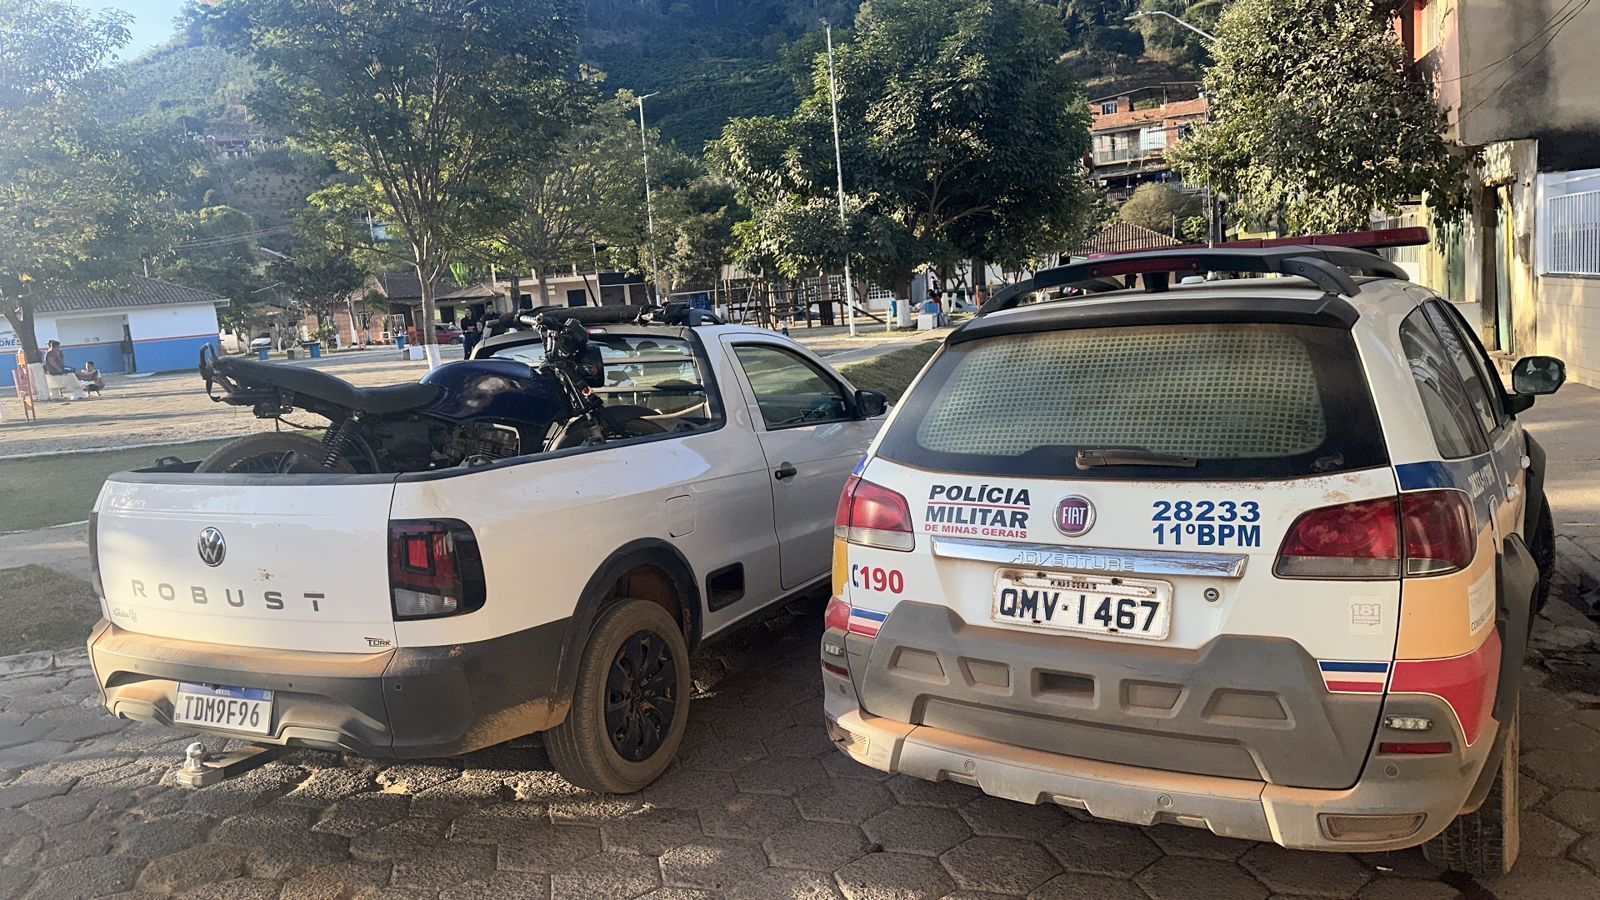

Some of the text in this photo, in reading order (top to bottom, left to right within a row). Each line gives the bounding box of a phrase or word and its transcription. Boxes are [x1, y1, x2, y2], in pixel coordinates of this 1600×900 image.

[929, 484, 1031, 506] POLÍCIA
[925, 506, 1029, 529] MILITAR
[1061, 506, 1087, 525] FIAT
[1152, 500, 1261, 522] 28233
[924, 524, 1028, 539] DE MINAS GERAIS
[1009, 551, 1136, 571] ADVENTURE
[860, 566, 904, 594] 190
[1050, 579, 1070, 588] MNAS
[131, 579, 325, 612] ROBUST
[1352, 604, 1380, 616] 181
[365, 637, 391, 648] TORK
[185, 695, 260, 727] TDM9F96
